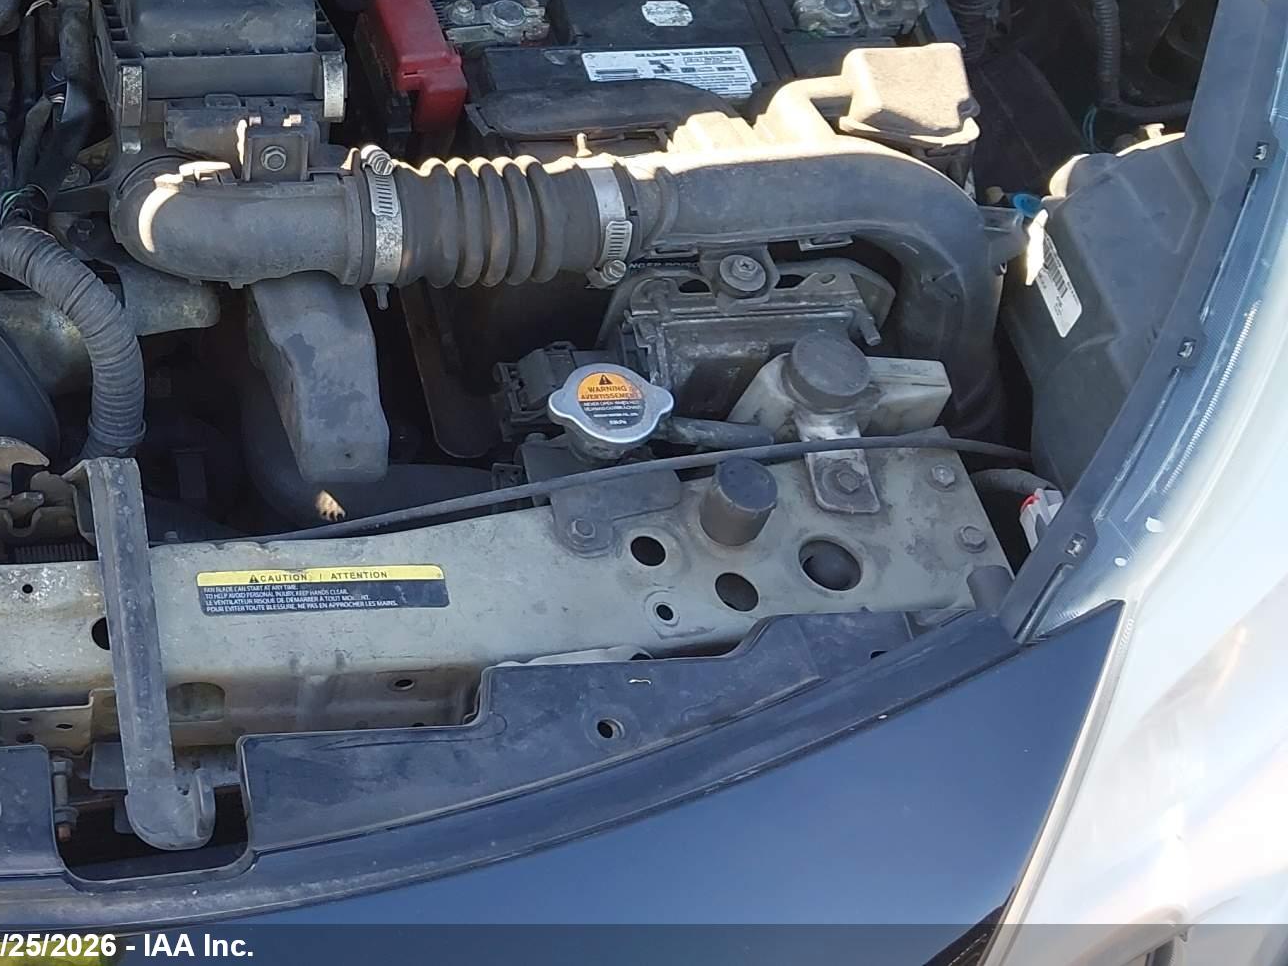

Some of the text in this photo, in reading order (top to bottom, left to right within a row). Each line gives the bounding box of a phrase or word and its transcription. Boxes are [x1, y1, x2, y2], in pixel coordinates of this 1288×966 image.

[587, 385, 627, 393] WARNING
[260, 571, 388, 583] CAUTION ATTENTION
